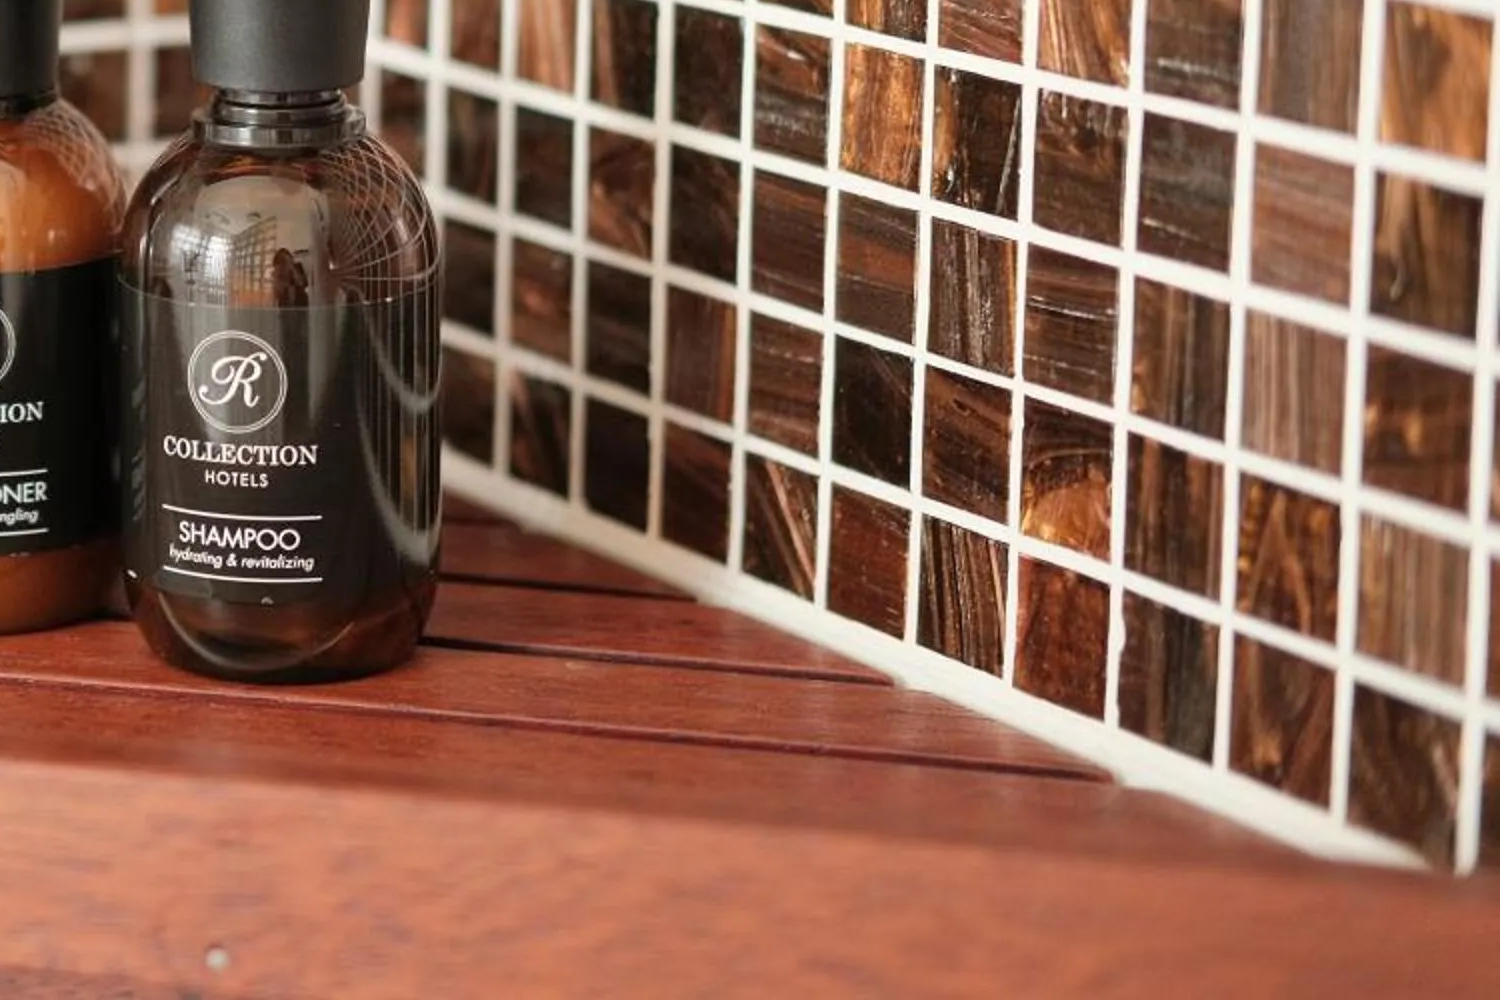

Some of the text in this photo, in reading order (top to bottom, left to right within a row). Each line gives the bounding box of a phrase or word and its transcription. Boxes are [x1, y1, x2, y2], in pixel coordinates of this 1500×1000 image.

[199, 351, 267, 409] R
[163, 435, 318, 467] COLLECTION
[204, 469, 269, 488] HOTELS
[178, 520, 300, 551] SHAMPOO
[169, 544, 314, 573] hydrating & revitalizing
